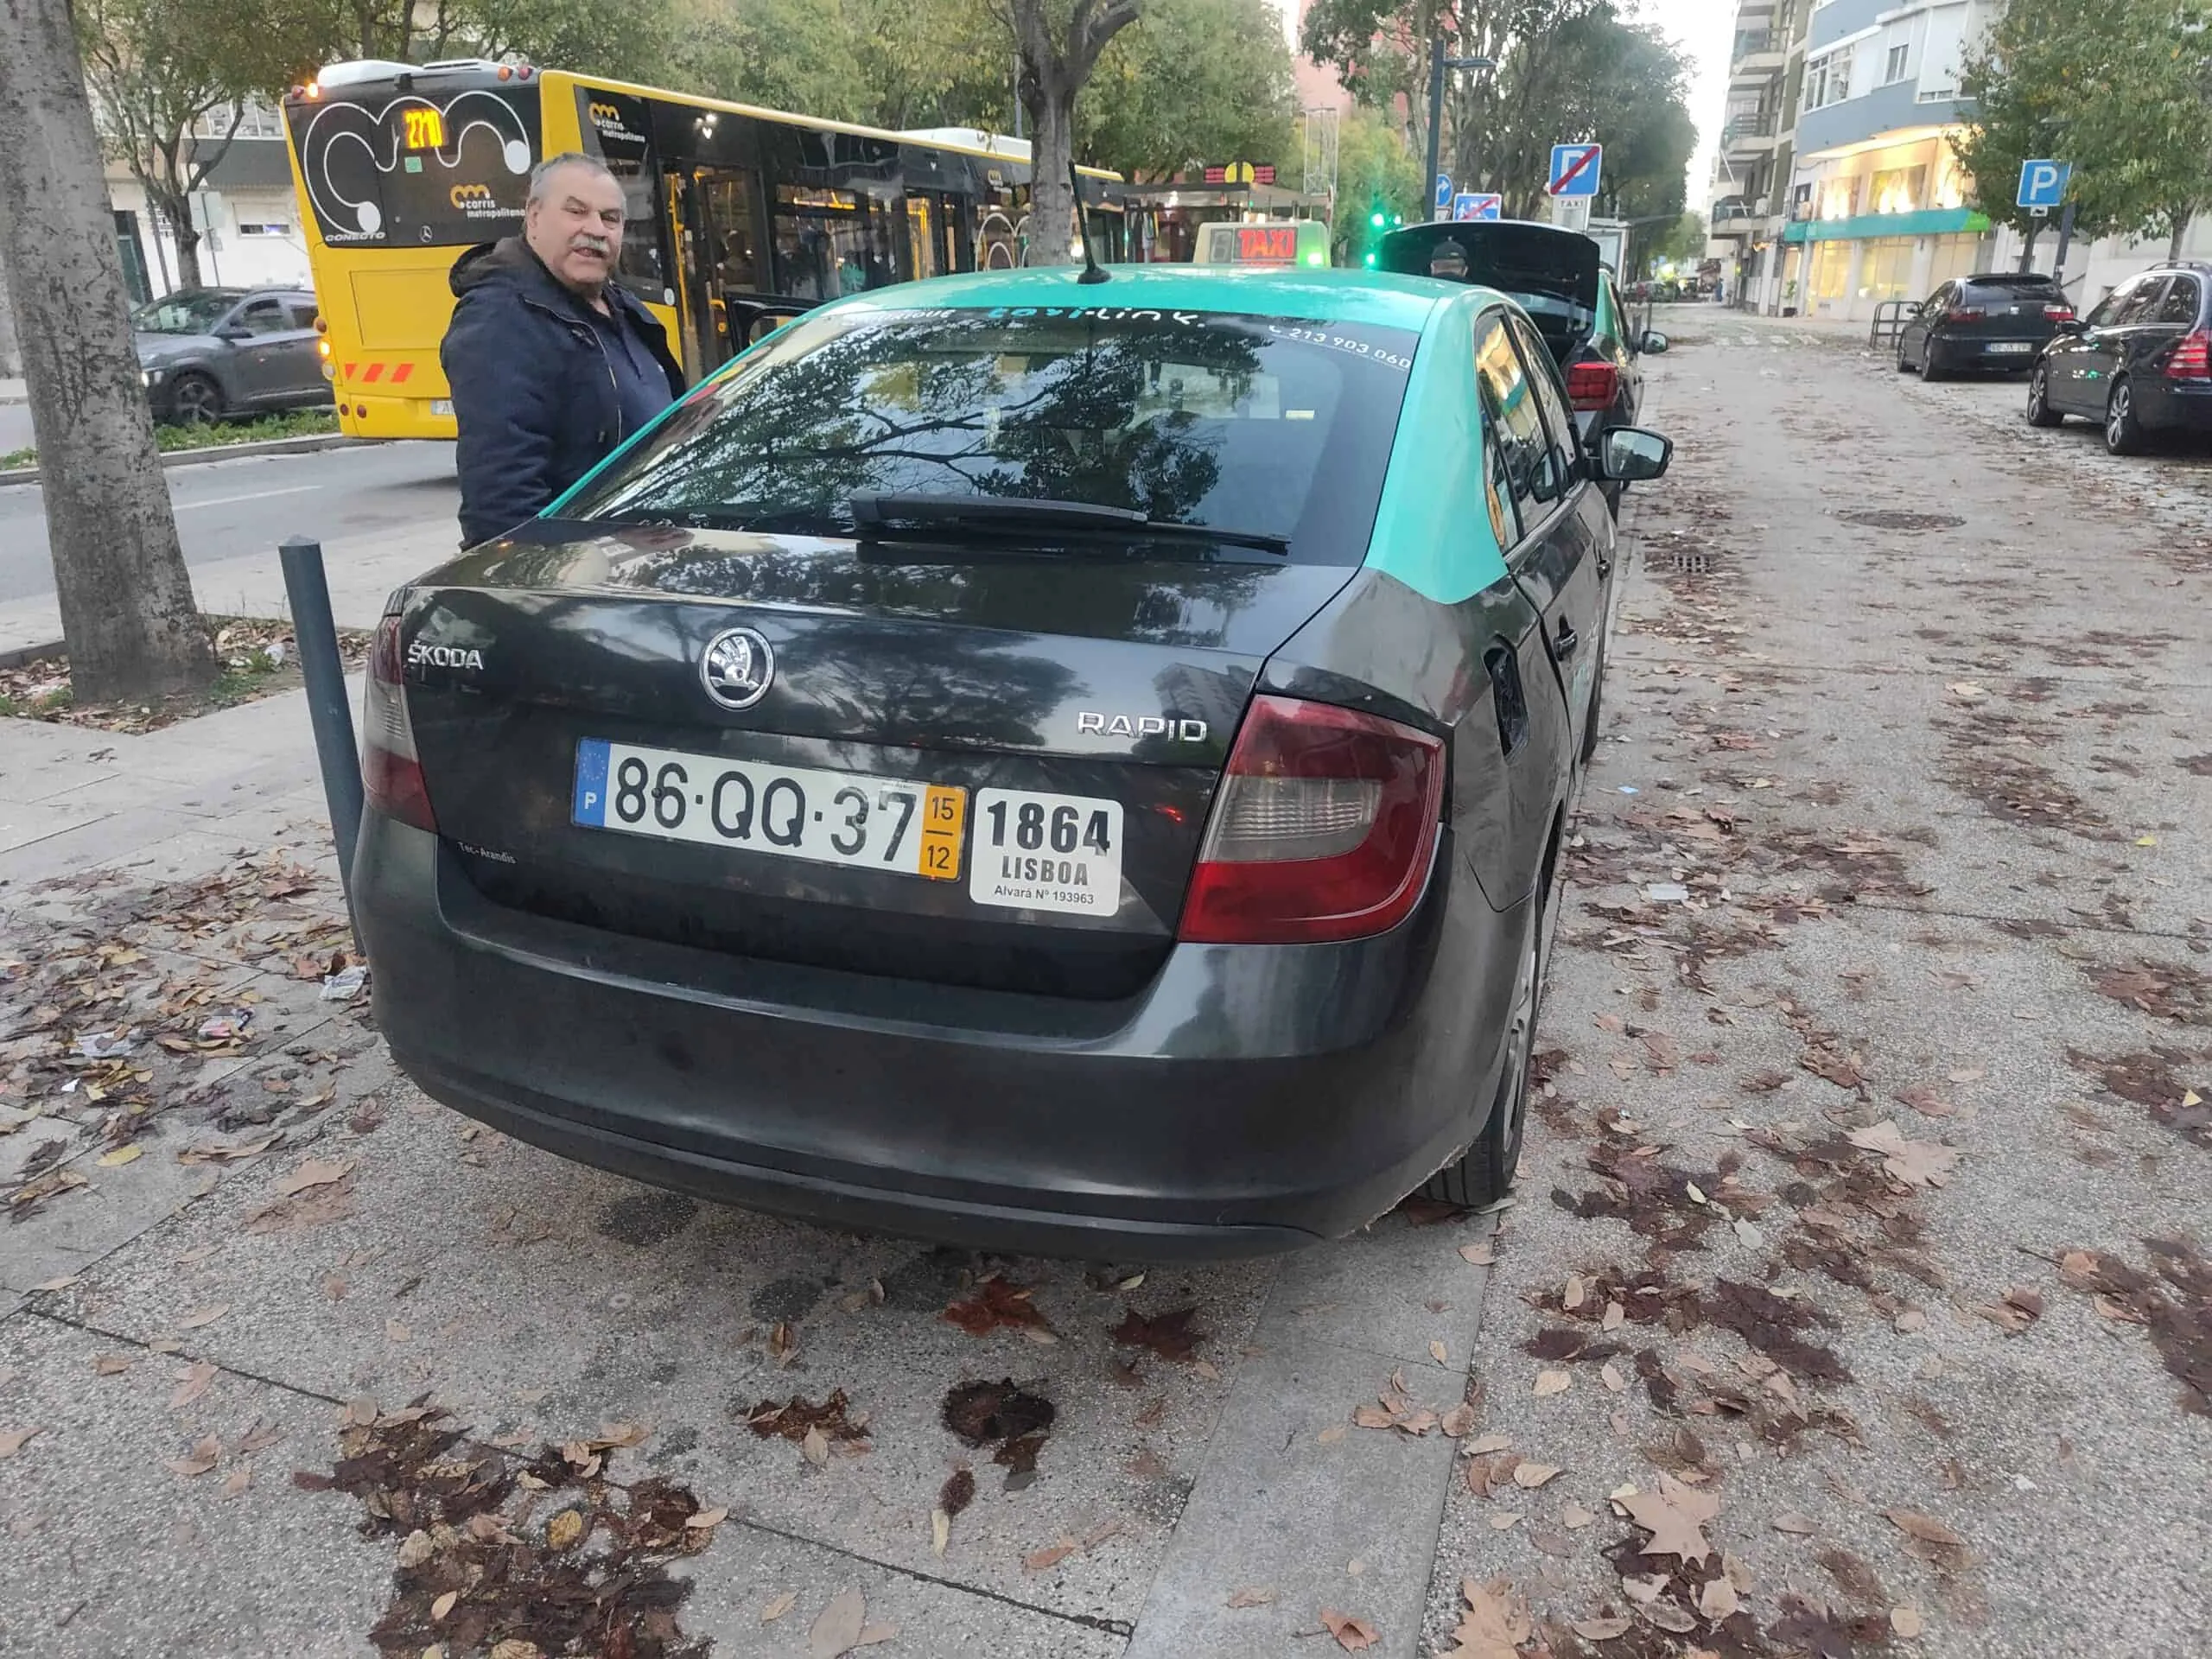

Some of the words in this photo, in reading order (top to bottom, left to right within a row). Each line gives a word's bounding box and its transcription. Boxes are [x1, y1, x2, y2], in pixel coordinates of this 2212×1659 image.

[405, 109, 442, 149] 2710
[2030, 167, 2057, 200] P
[1560, 200, 1584, 208] TAXI
[1238, 228, 1295, 258] TAXI
[1288, 327, 1327, 343] 213
[1333, 337, 1370, 353] 903
[1374, 349, 1412, 369] 060
[408, 640, 485, 670] ŠKODA
[1077, 711, 1208, 741] RAPID
[584, 791, 596, 810] P
[931, 796, 955, 821] 15
[987, 800, 1110, 856] 1864
[926, 845, 950, 869] 12
[1001, 855, 1088, 886] LISBOA
[995, 884, 1032, 899] Alvará
[1052, 891, 1094, 905] 193963
